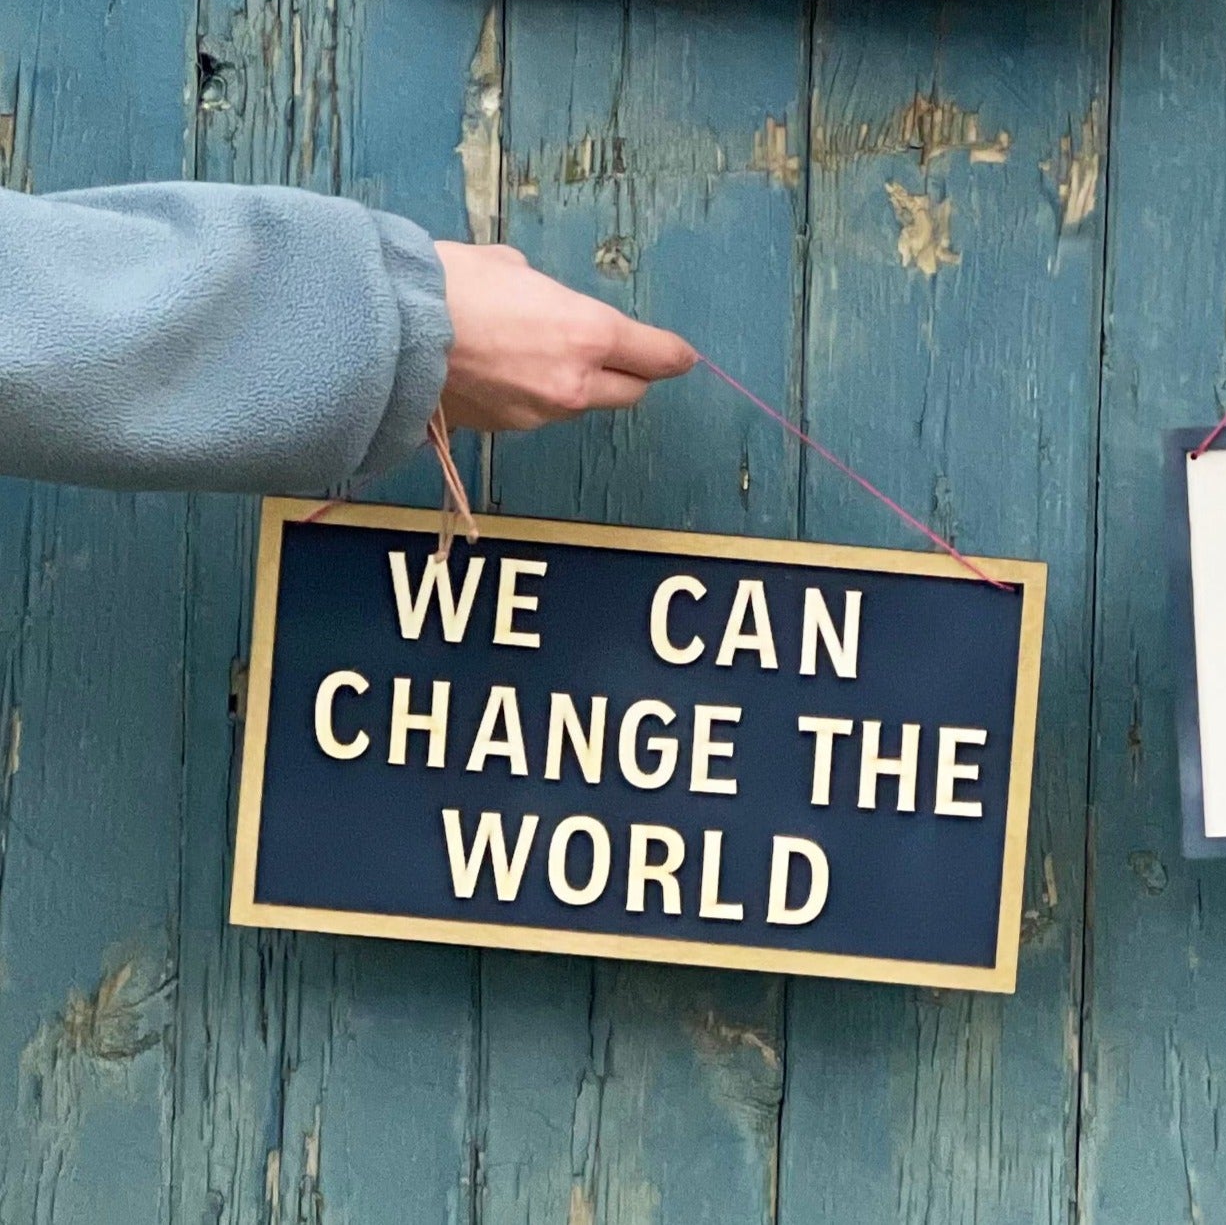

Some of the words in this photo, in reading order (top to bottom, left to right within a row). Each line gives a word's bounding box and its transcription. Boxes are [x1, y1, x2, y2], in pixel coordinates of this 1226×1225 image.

[388, 550, 547, 648] WE
[649, 574, 862, 679] CAN
[314, 670, 742, 795] CHANGE
[799, 716, 987, 818] THE
[442, 808, 830, 926] WORLD
